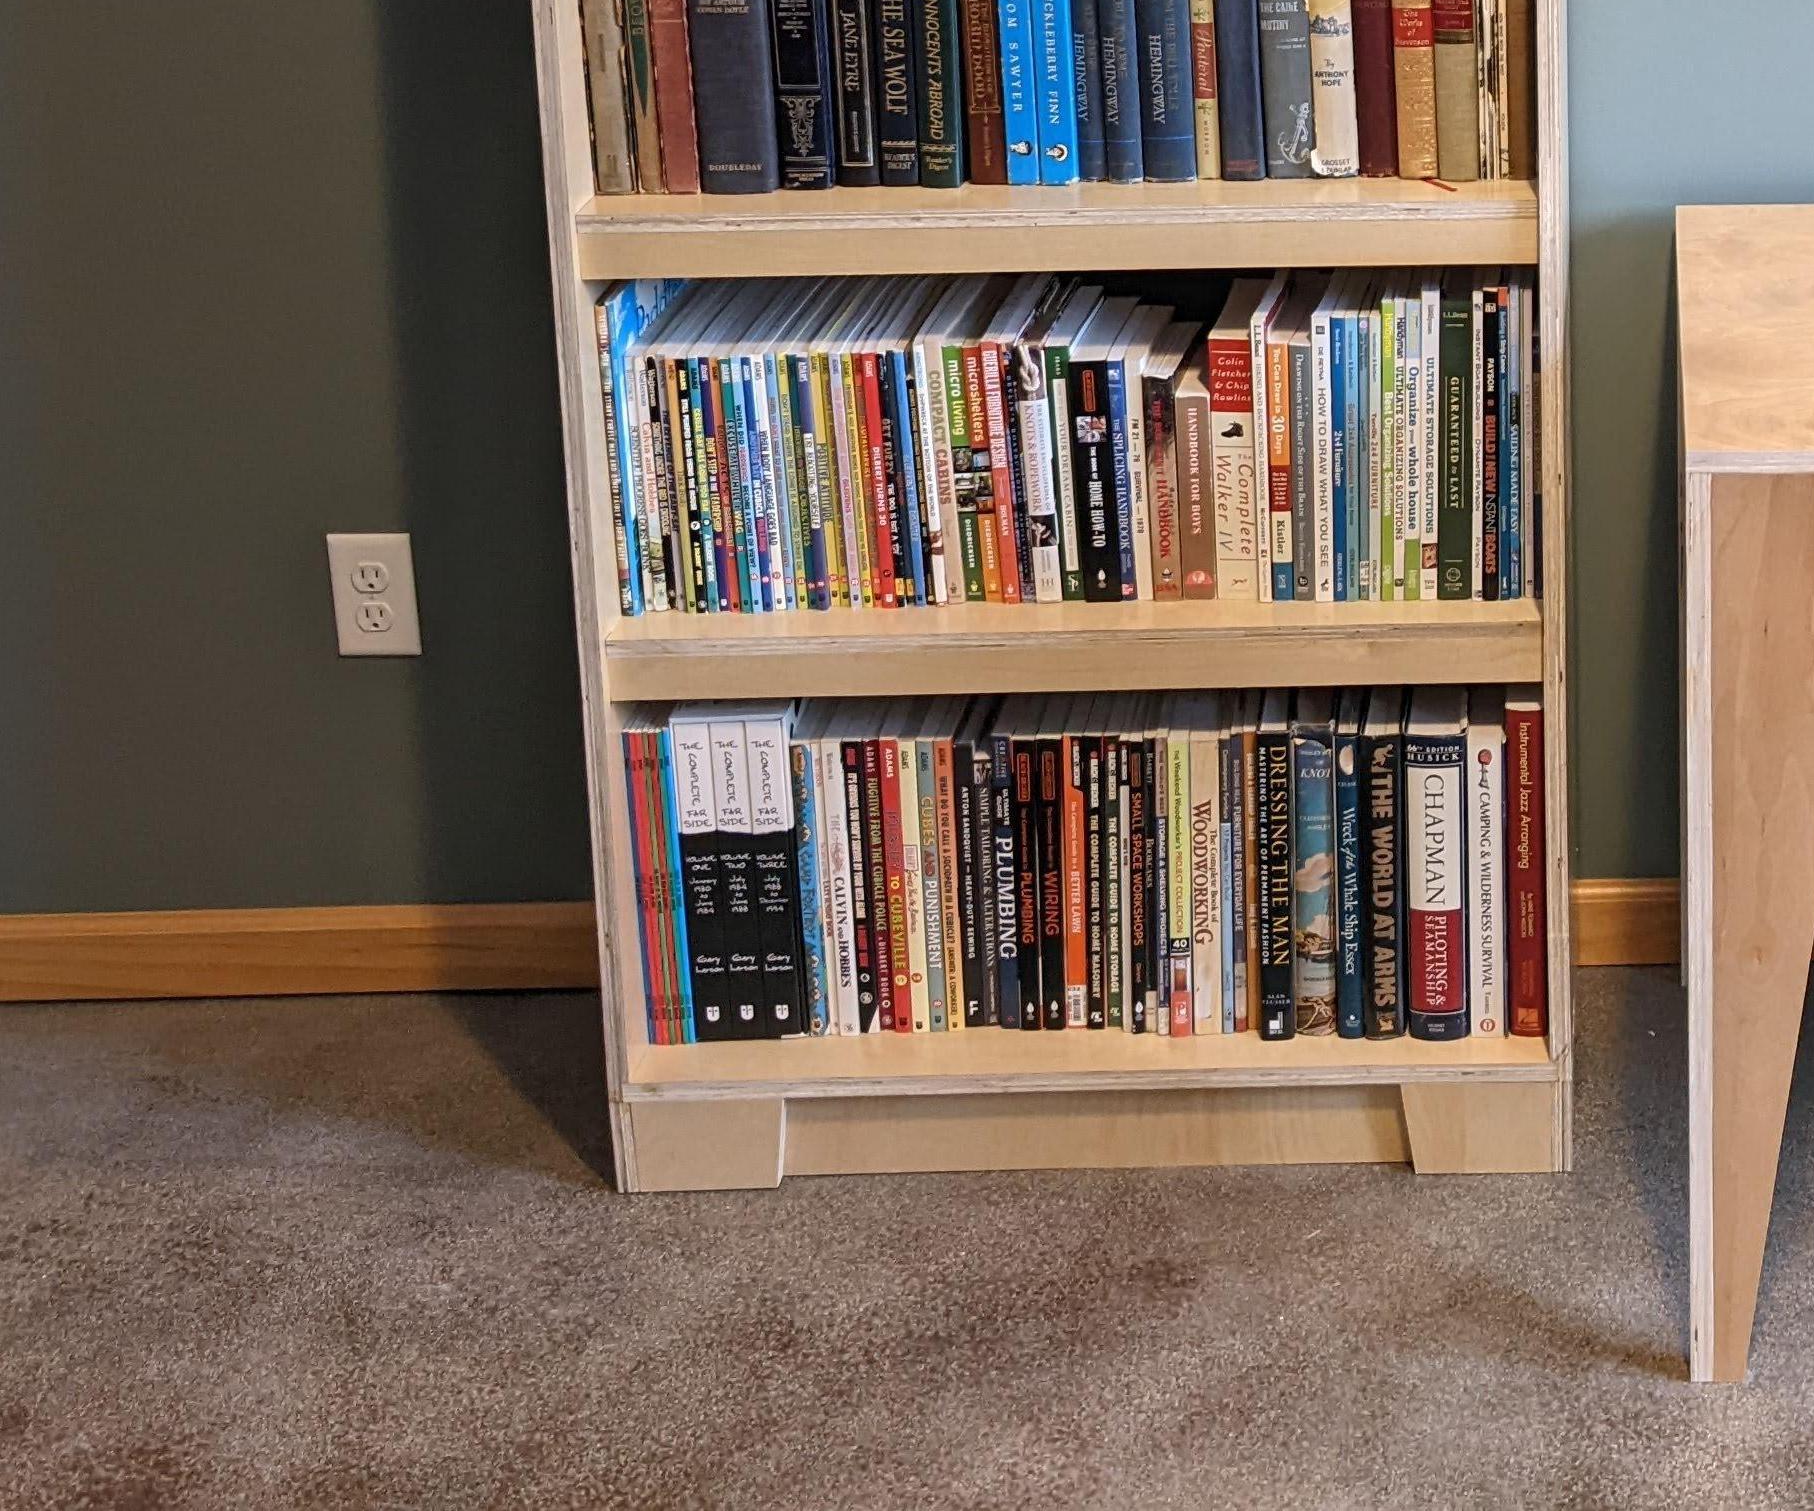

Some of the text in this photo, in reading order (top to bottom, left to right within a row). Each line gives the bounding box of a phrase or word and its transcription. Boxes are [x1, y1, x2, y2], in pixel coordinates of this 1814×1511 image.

[840, 10, 858, 48] JANE
[845, 52, 859, 92] EYRE
[884, 26, 904, 62] SEA
[886, 65, 907, 115] WOLF
[929, 79, 943, 140] ABROAD
[1009, 42, 1023, 113] SAWYER
[1048, 91, 1060, 125] FINN
[1102, 37, 1119, 126] HEMINGWAY
[1148, 34, 1165, 125] HEMINGWAY
[929, 370, 951, 505] COMPACT CABINS
[948, 359, 965, 435] micro living
[966, 356, 986, 442] microshelters
[984, 351, 1007, 469] GUERILLA FURNITURE DESIGN
[1187, 407, 1202, 535] HANDBOOK FOR BOYS
[1217, 455, 1235, 551] Walker IV
[1236, 464, 1254, 555] Complete
[1317, 388, 1329, 567] HOW TO DRAW WHAT YOU SEE
[1276, 520, 1287, 554] Kistler
[1423, 773, 1445, 905] CHAPMAN
[1517, 722, 1532, 869] Instrumental Jazz Arranging
[995, 836, 1017, 959] PLUMBING
[1191, 800, 1213, 945] WOODWORKING
[1269, 746, 1290, 966] DRESSING THE MAN
[1372, 775, 1395, 1006] THE WORLD AT ARMS
[1479, 792, 1495, 988] CAMPING & WILDERNESS SURVIVAL
[925, 880, 943, 969] PUNISHMENT
[1019, 872, 1034, 944] PLUMBING
[1043, 871, 1059, 936] WIRING
[1425, 915, 1436, 1006] SEAMANSHIP
[1435, 915, 1447, 1005] PILOTING &
